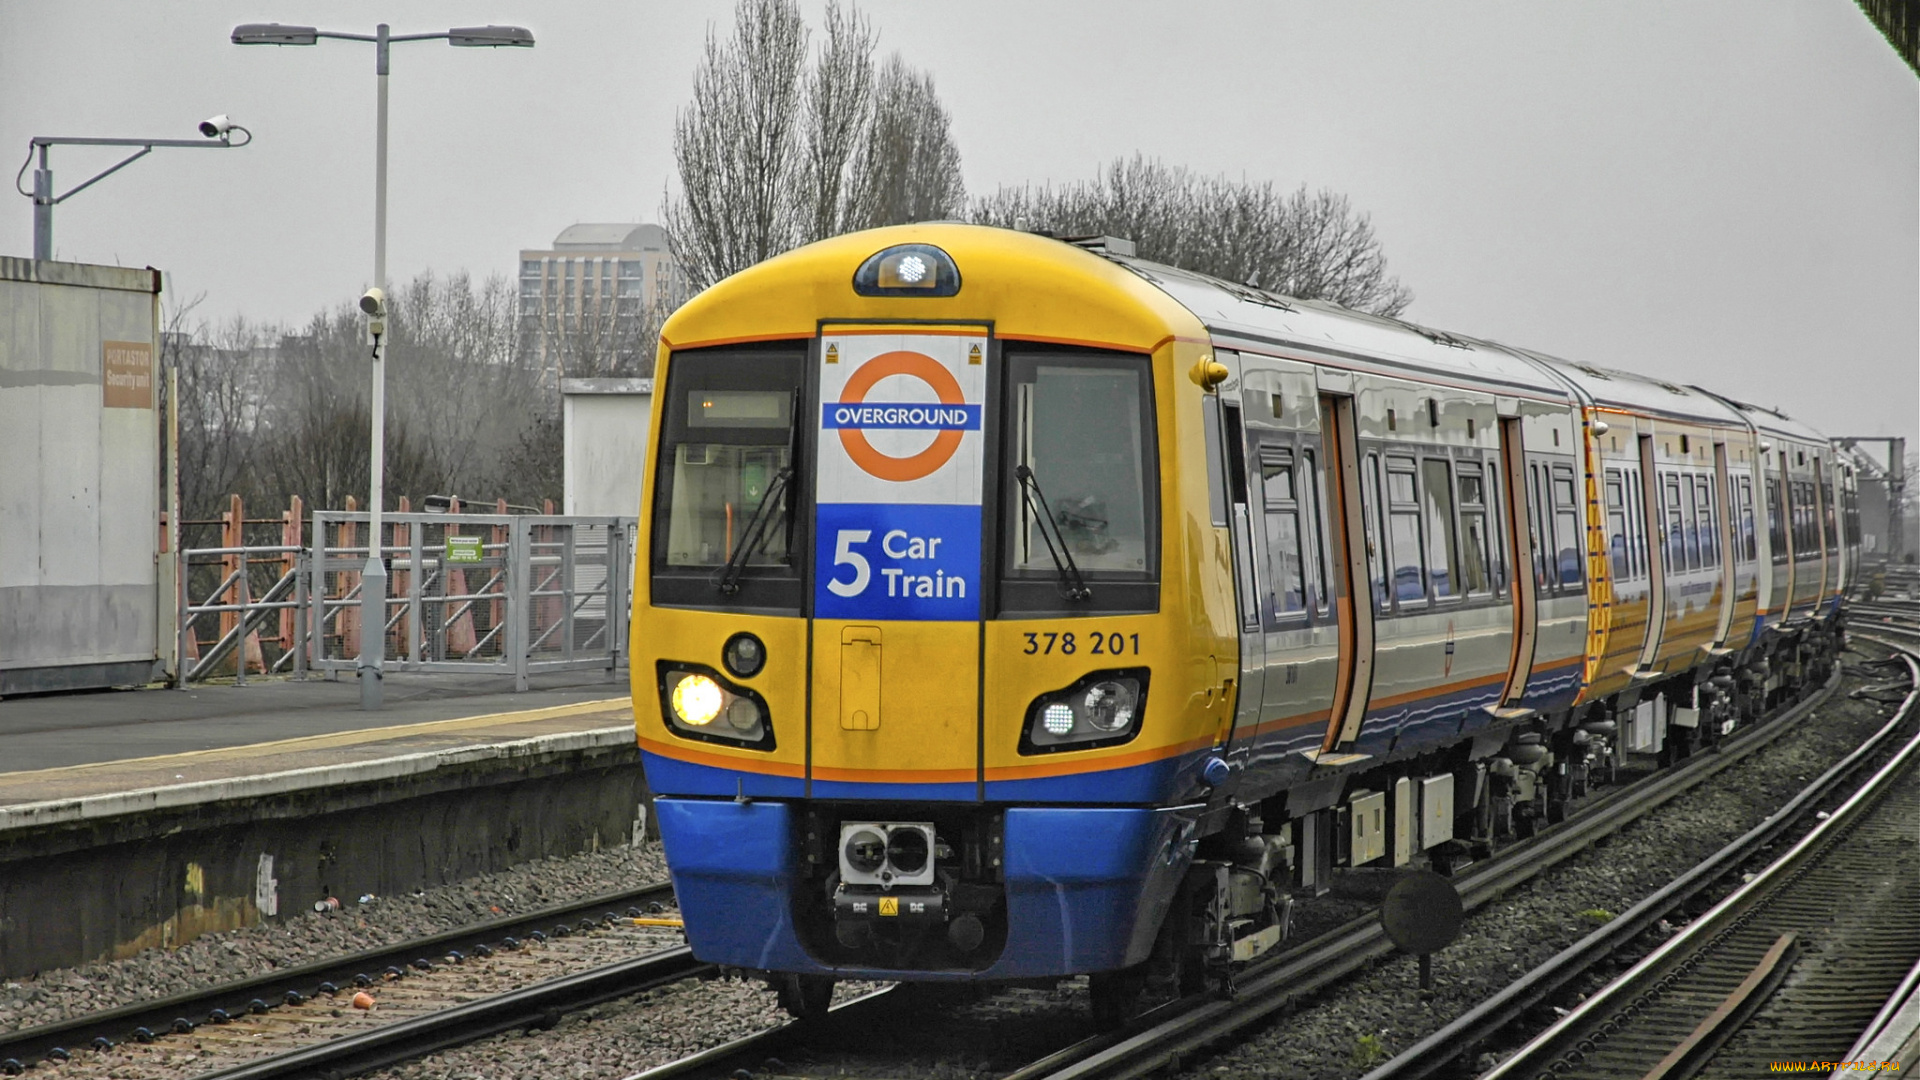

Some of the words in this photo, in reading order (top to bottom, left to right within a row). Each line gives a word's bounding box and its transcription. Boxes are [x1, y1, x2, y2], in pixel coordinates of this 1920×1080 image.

[106, 369, 135, 390] Security
[136, 371, 150, 388] unit
[834, 407, 968, 425] OVERGROUND
[826, 529, 872, 598] 5
[882, 529, 942, 560] Car
[881, 568, 966, 598] Train
[1023, 632, 1077, 655] 378
[1089, 631, 1139, 656] 201
[853, 902, 867, 913] DC
[909, 902, 924, 913] DC
